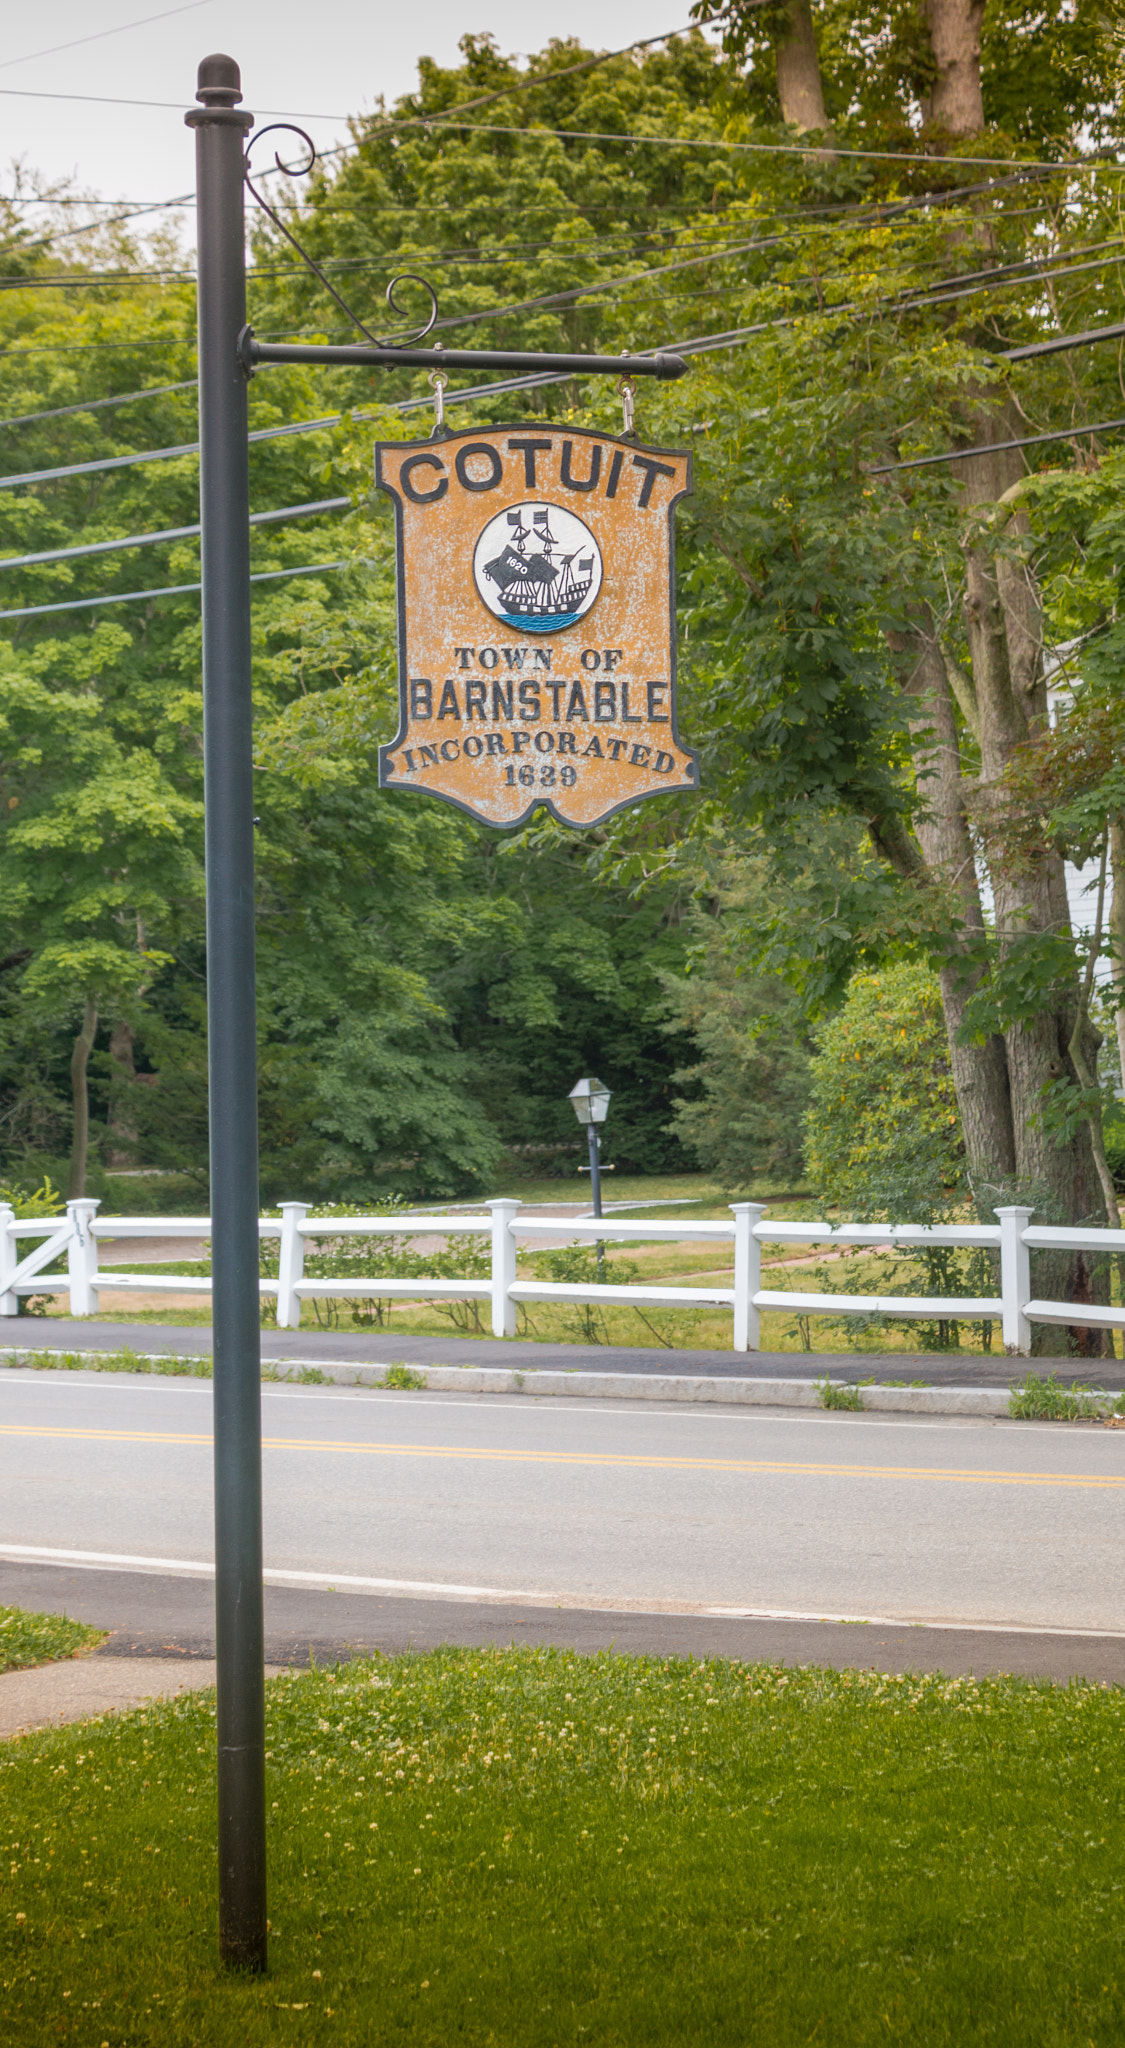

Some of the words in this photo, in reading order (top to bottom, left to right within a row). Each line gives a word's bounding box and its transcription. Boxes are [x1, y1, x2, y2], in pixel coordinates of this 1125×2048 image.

[400, 438, 676, 507] COTUIT
[506, 556, 528, 574] 1620
[454, 647, 553, 670] TOWN
[580, 649, 623, 671] OF
[411, 678, 669, 722] BARNSTABLE
[402, 731, 675, 774] INCORPORATED
[504, 764, 577, 786] 1639
